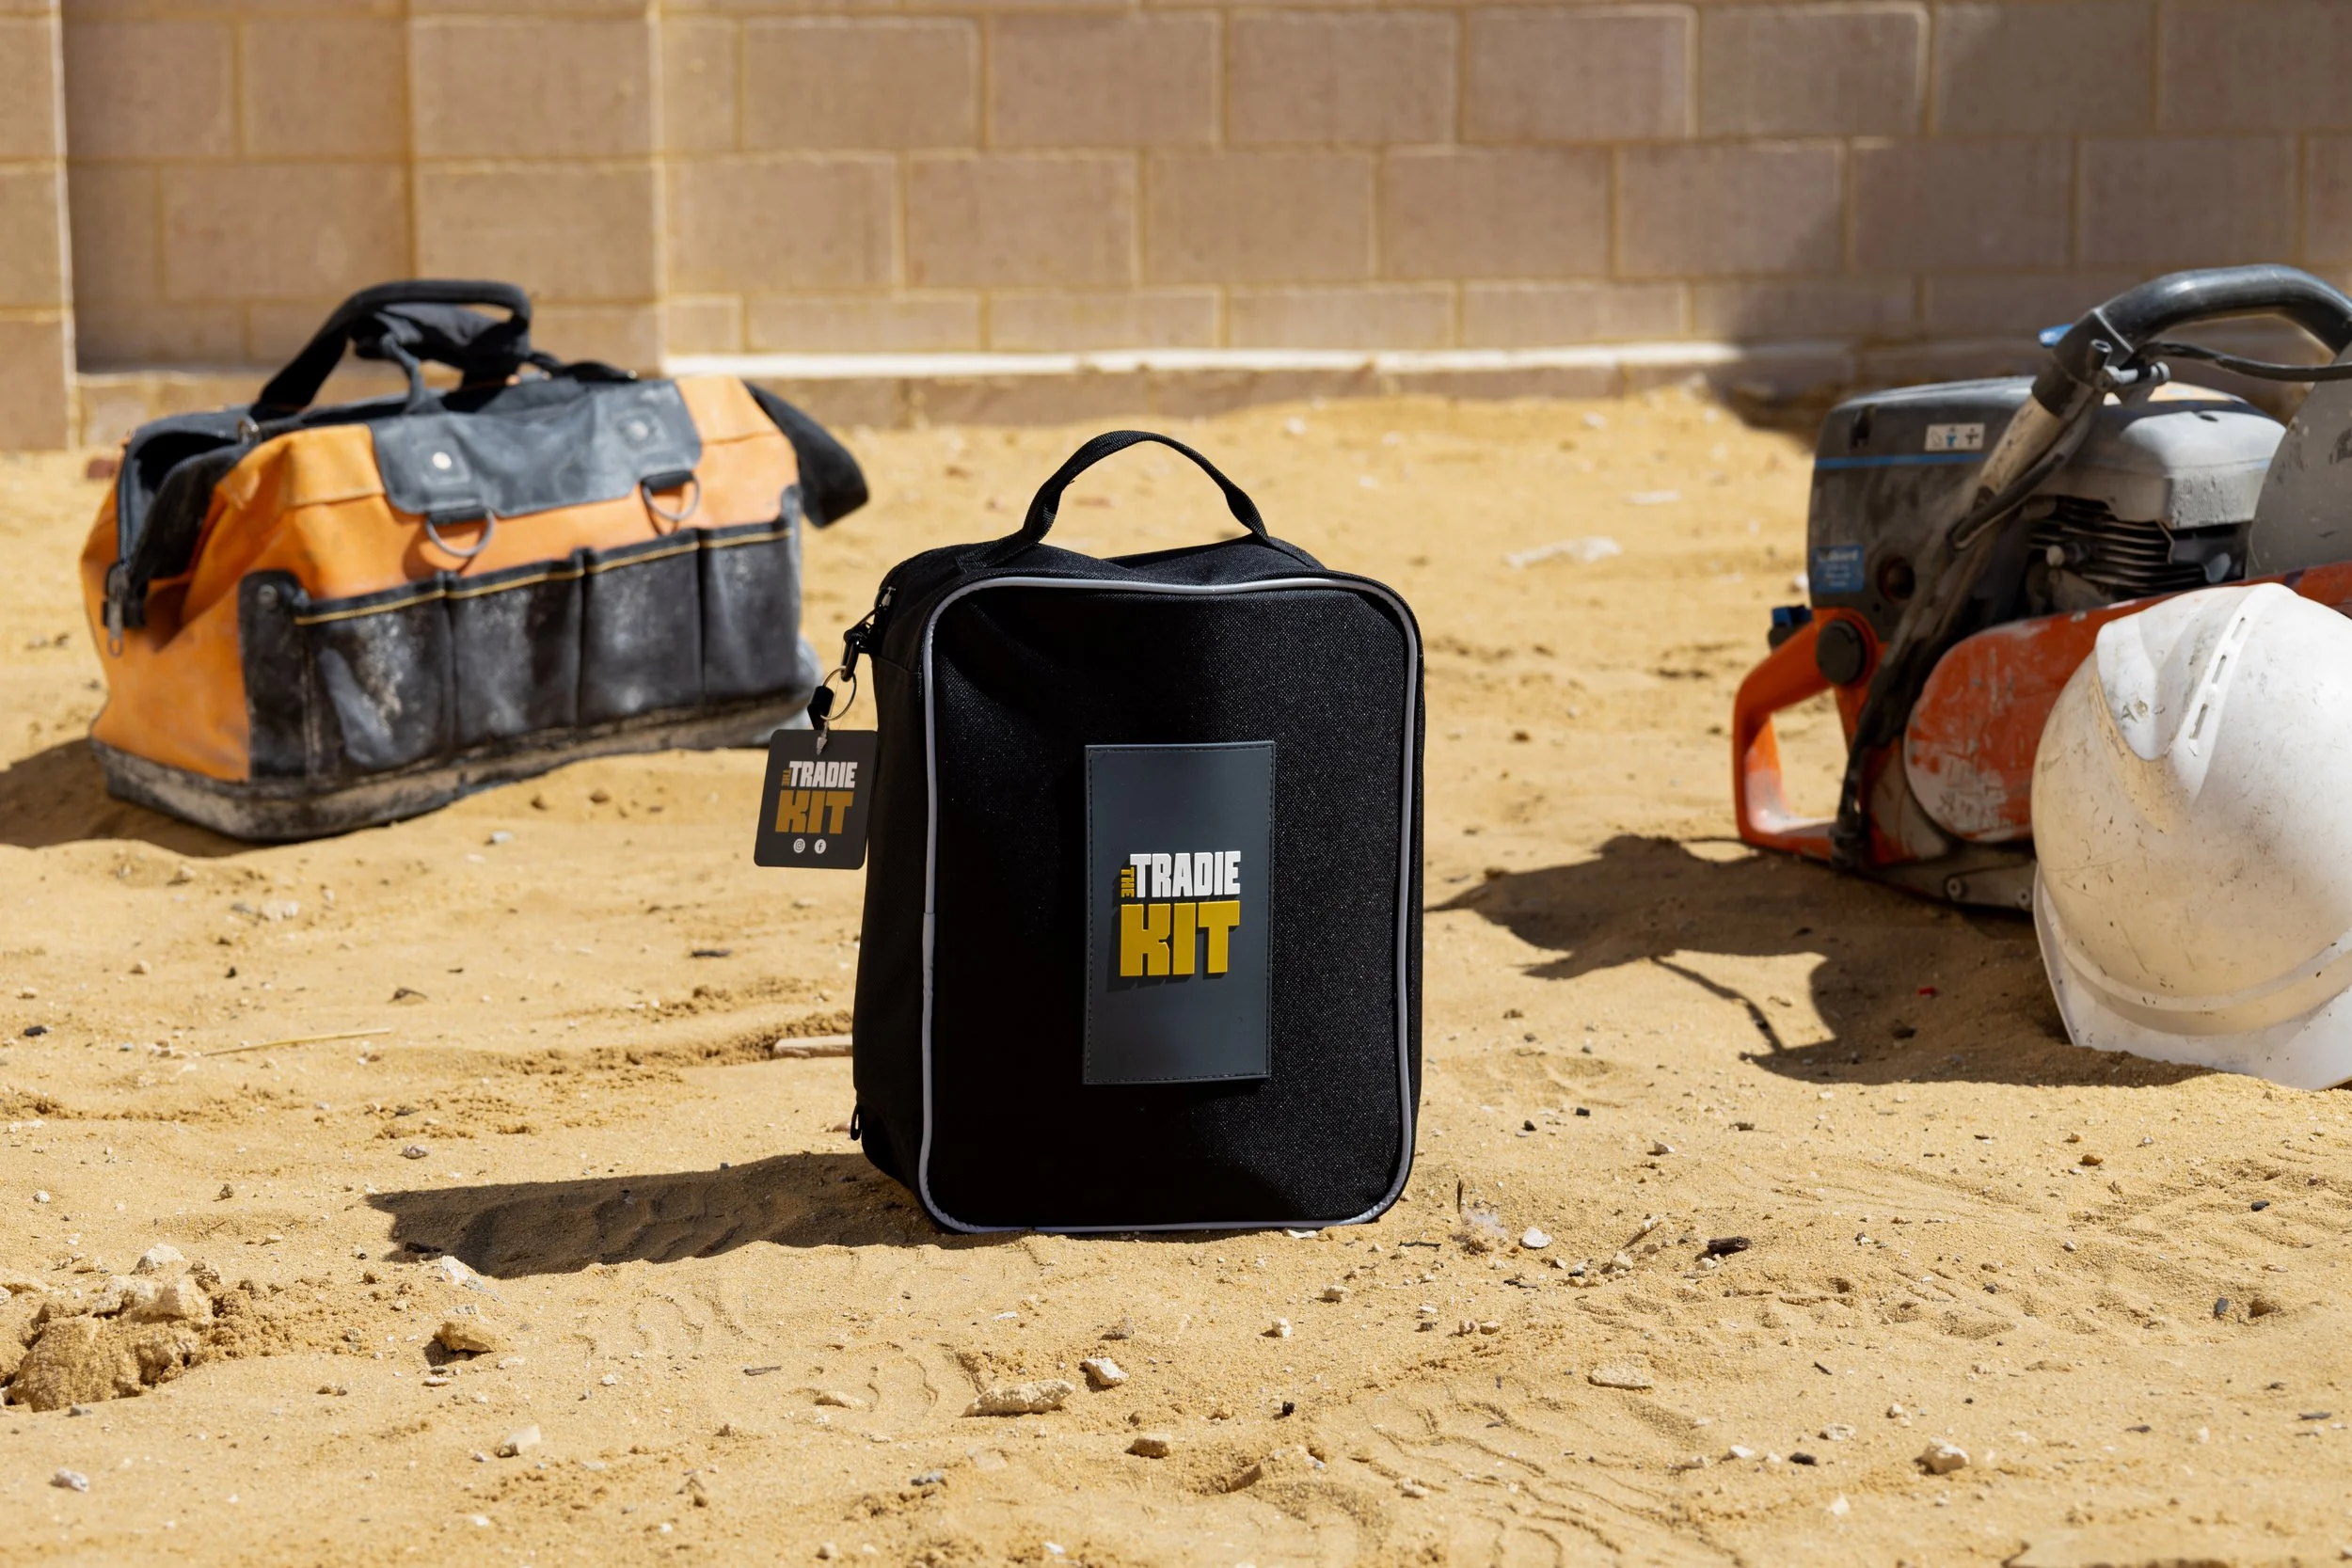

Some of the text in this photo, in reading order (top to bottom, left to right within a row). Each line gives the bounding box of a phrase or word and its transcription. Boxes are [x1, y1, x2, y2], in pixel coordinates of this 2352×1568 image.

[782, 768, 791, 786] THE
[789, 760, 858, 788] TRADIE
[775, 790, 854, 834] KIT
[1120, 867, 1135, 898] THE
[1130, 850, 1241, 898] TRADIE
[1120, 900, 1240, 977] KIT
